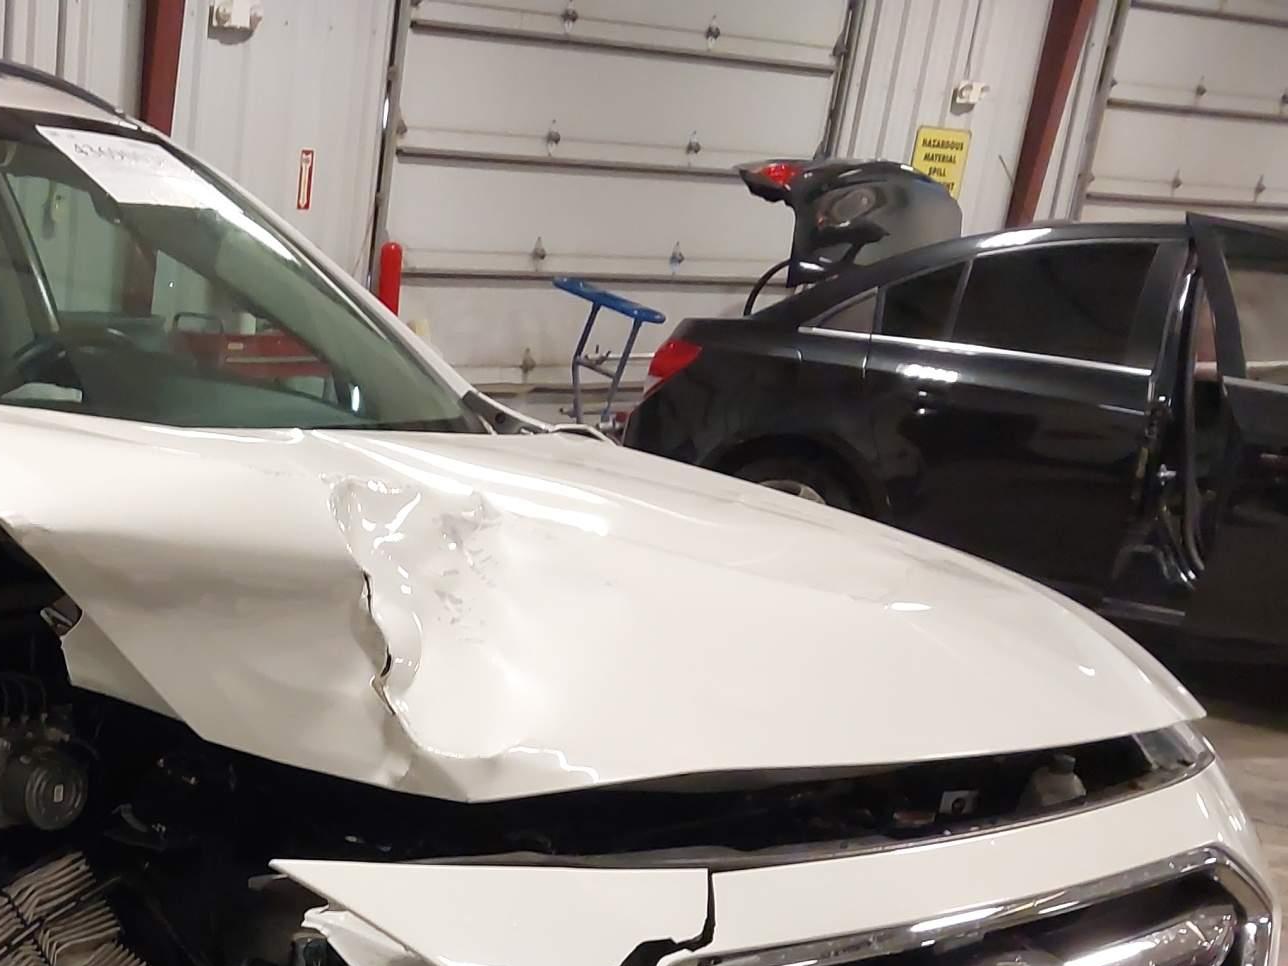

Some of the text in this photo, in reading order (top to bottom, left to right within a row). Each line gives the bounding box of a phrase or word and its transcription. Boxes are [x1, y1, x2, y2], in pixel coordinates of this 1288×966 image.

[922, 138, 964, 151] HAZARDOUS
[924, 153, 956, 164] MATERIAL
[928, 167, 946, 177] SPILL
